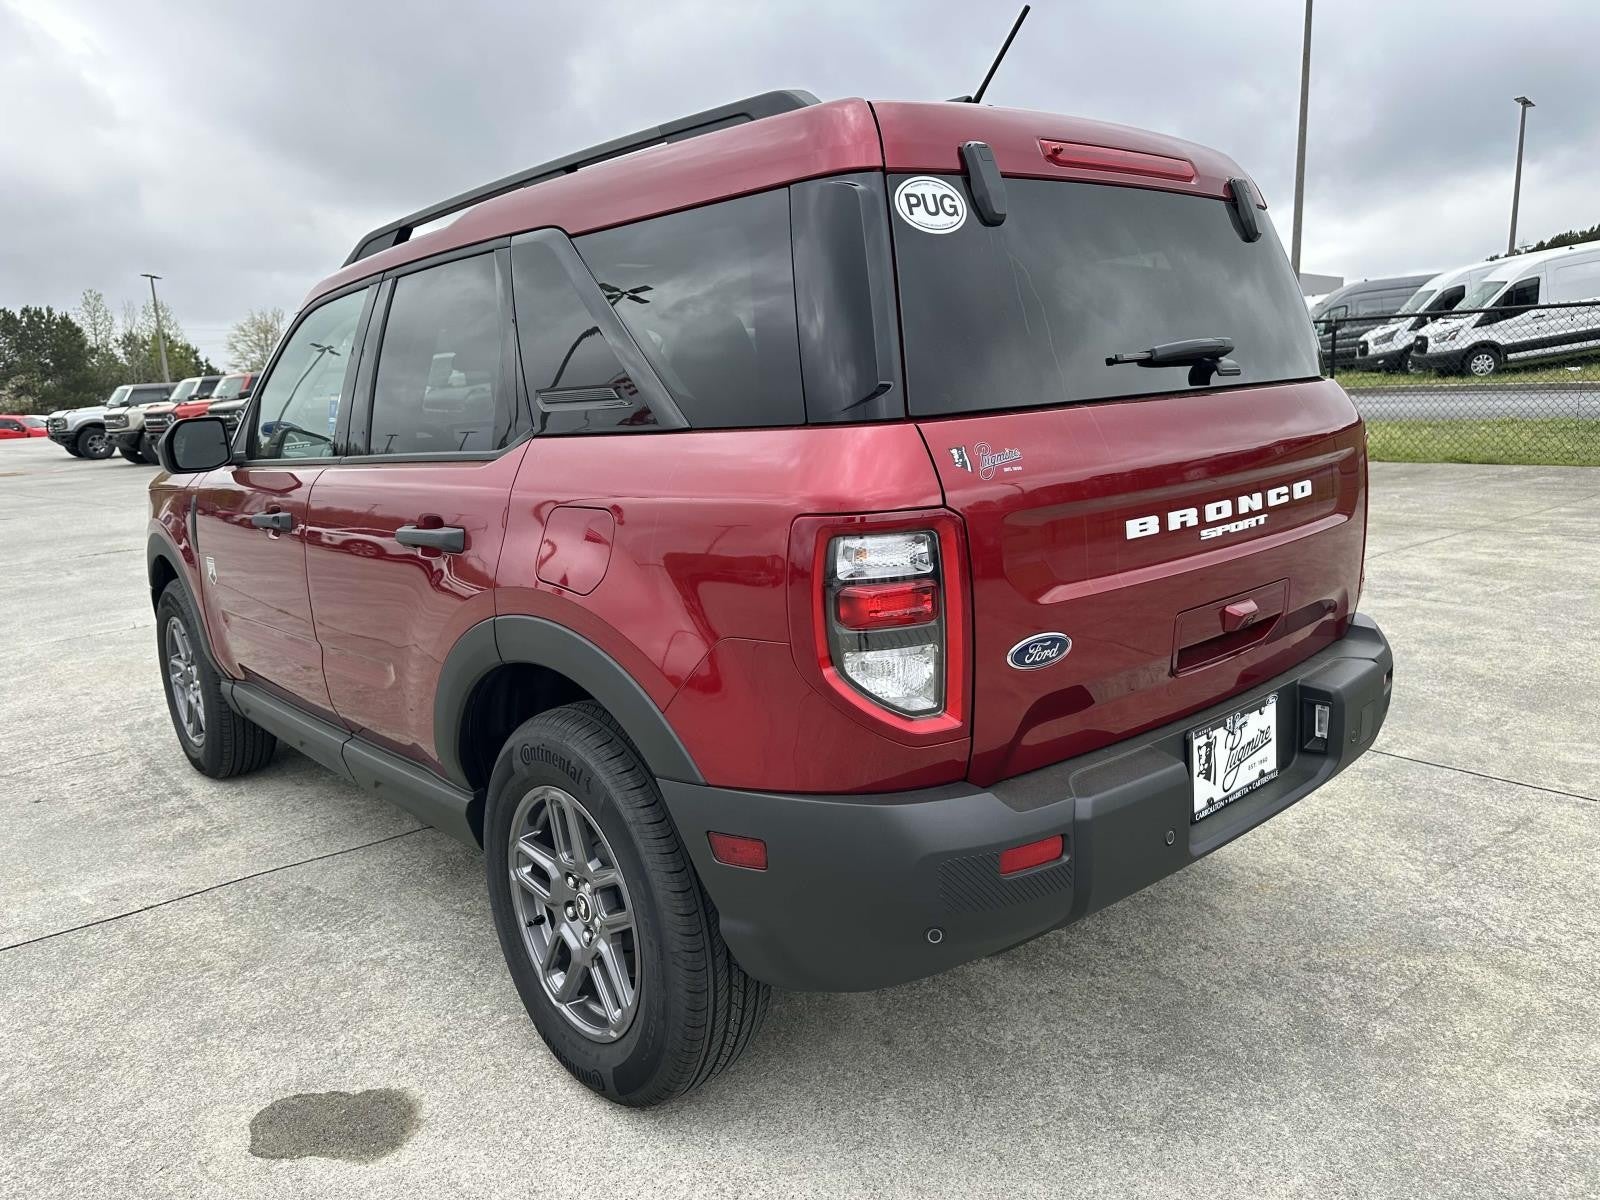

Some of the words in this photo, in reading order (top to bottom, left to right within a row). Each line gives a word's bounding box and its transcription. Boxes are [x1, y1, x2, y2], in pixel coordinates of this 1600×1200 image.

[904, 193, 959, 217] PUG
[1125, 479, 1312, 540] BRONCO
[1200, 513, 1268, 540] SPORT
[1024, 641, 1060, 663] Ford
[520, 743, 584, 785] Continental
[1222, 725, 1272, 792] Pugmire
